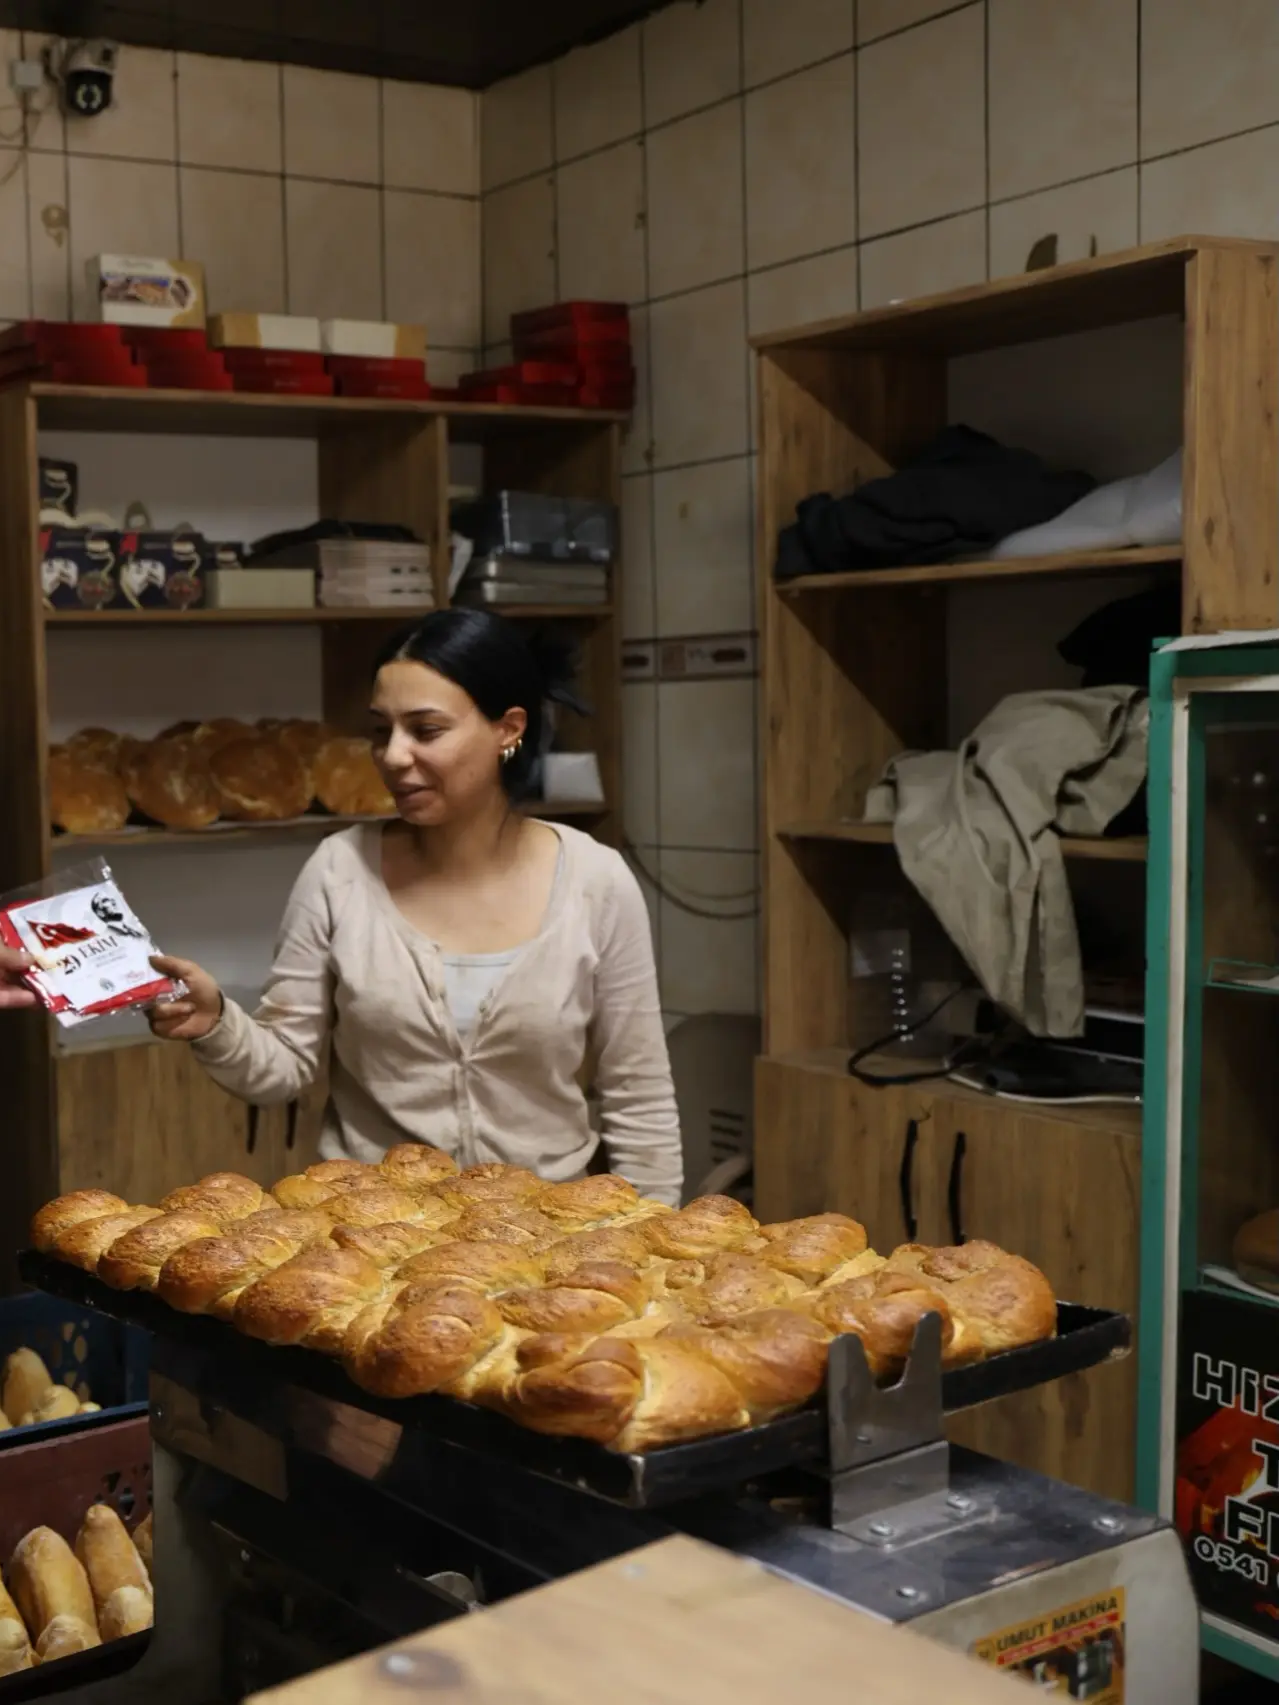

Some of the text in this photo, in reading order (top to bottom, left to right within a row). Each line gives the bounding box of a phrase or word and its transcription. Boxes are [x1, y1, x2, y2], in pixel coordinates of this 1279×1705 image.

[56, 954, 82, 976] 29
[1194, 1535, 1269, 1586] 0541
[996, 1621, 1048, 1652] UMUT
